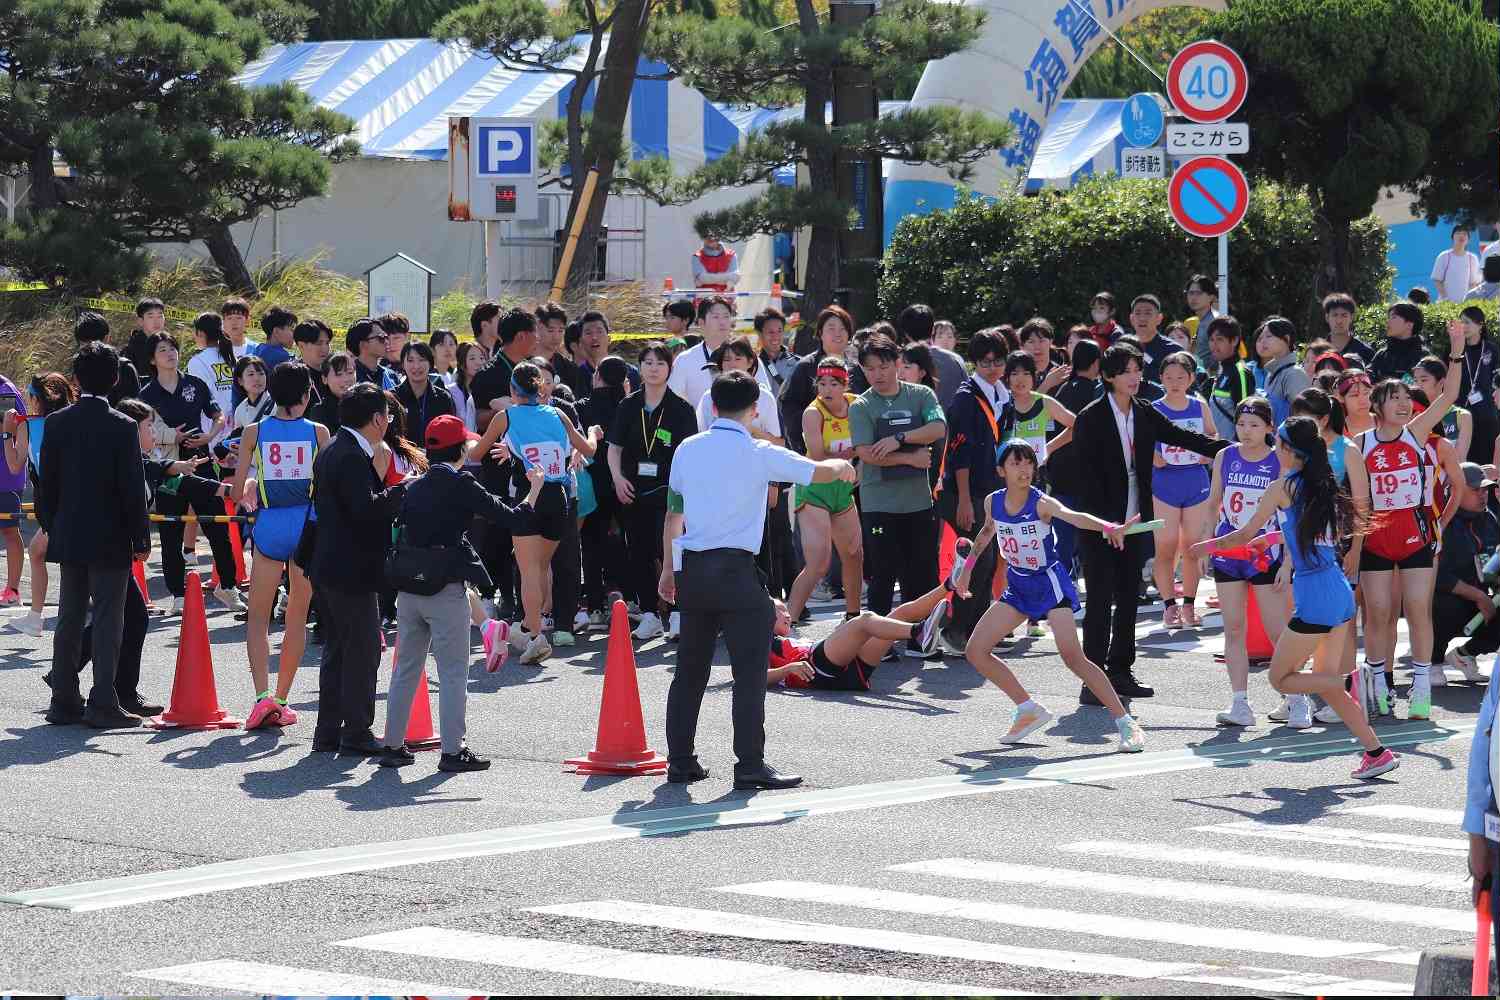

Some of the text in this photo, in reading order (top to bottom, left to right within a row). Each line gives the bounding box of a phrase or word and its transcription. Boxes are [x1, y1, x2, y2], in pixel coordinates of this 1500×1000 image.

[999, 0, 1125, 168] 横須賀
[1186, 64, 1229, 100] 40
[1172, 130, 1243, 147] ここから
[488, 130, 523, 171] P
[1125, 155, 1161, 173] 歩行者優先
[270, 443, 304, 466] 8-1
[525, 447, 561, 464] 2-1
[1373, 448, 1411, 470] 衣笠
[1228, 472, 1271, 488] SAKAMOTO
[1375, 473, 1418, 495] 19-2
[1230, 491, 1262, 513] 6-
[1002, 536, 1039, 553] 20-2
